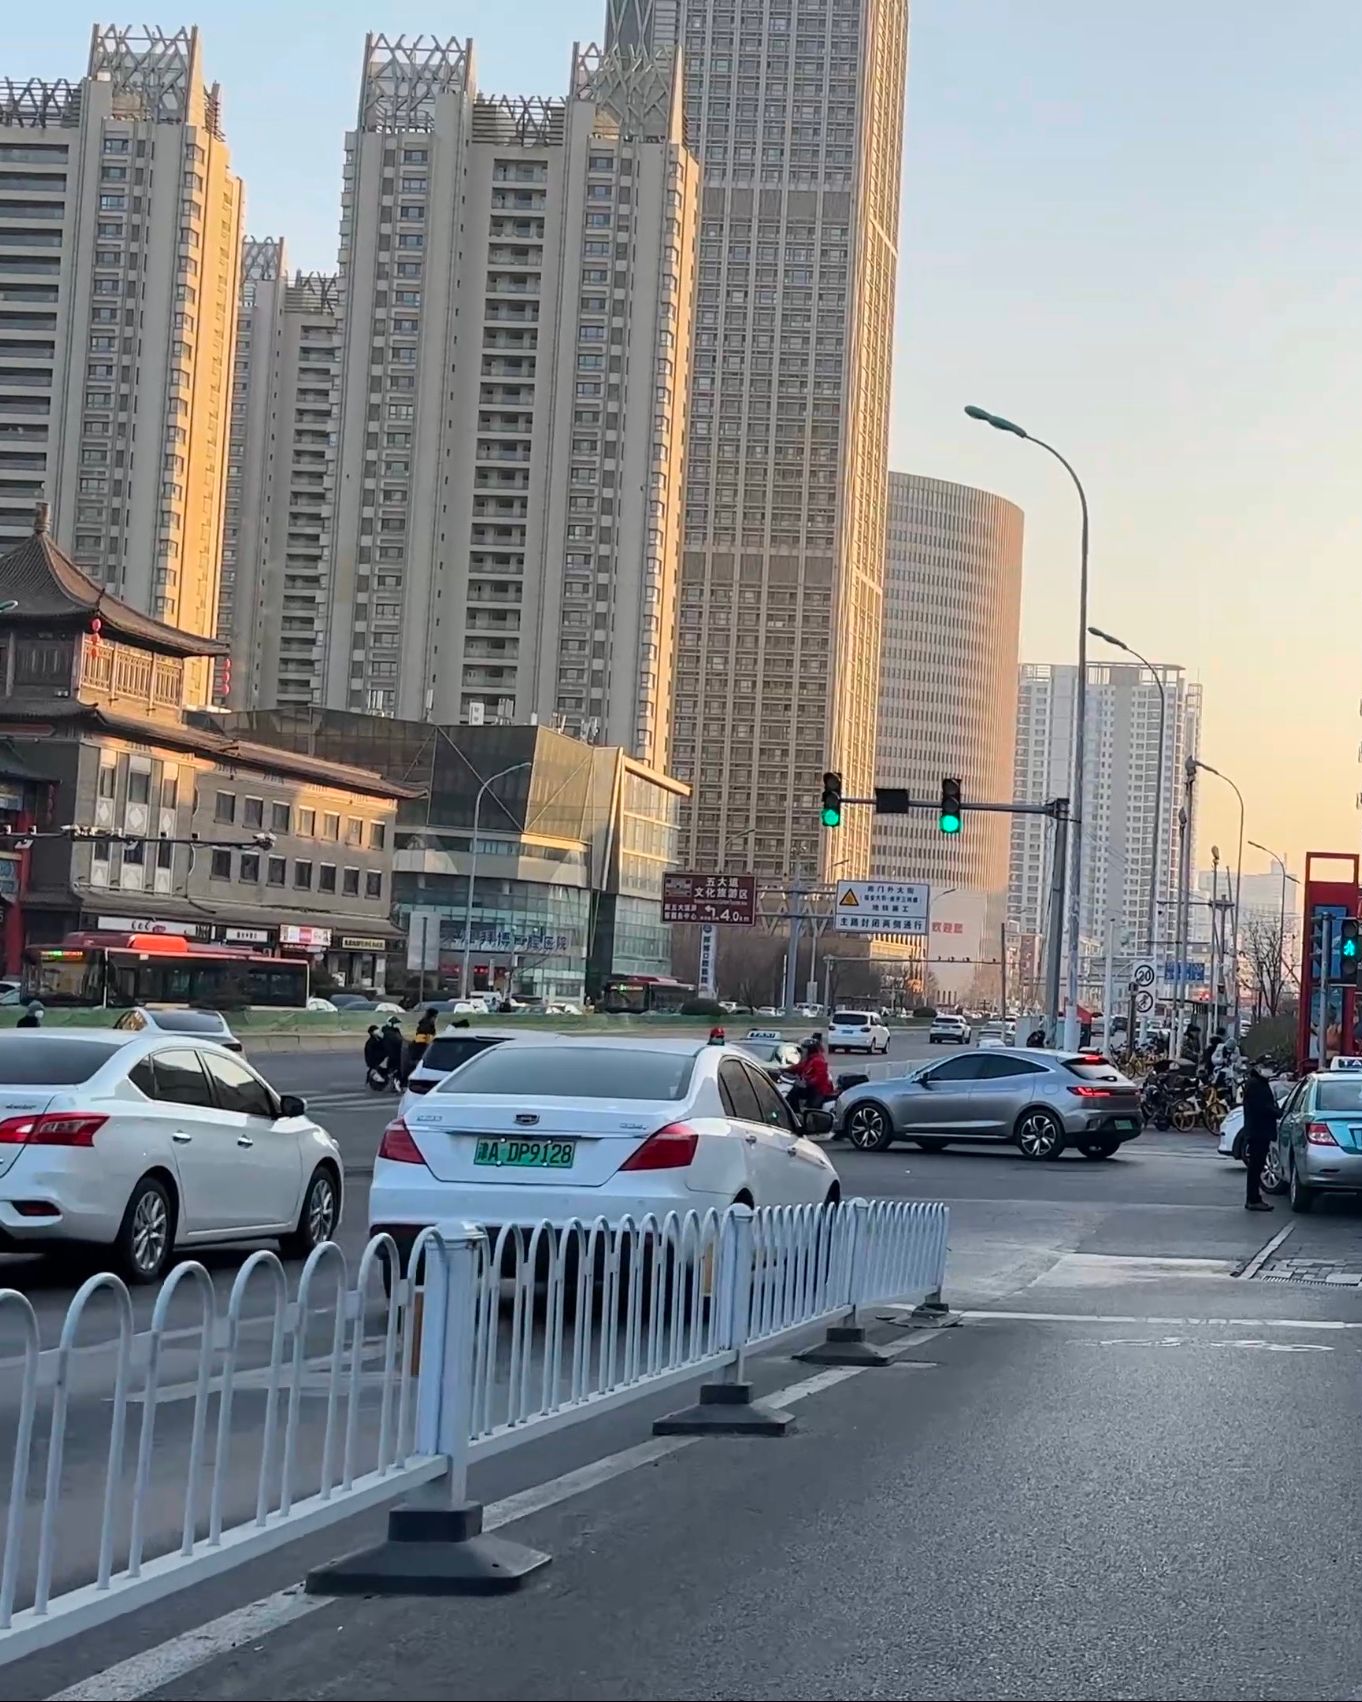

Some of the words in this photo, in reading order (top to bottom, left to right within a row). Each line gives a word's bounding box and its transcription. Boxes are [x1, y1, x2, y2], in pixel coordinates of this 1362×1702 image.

[694, 887, 748, 899] 文化旅游区
[1138, 969, 1151, 981] 20
